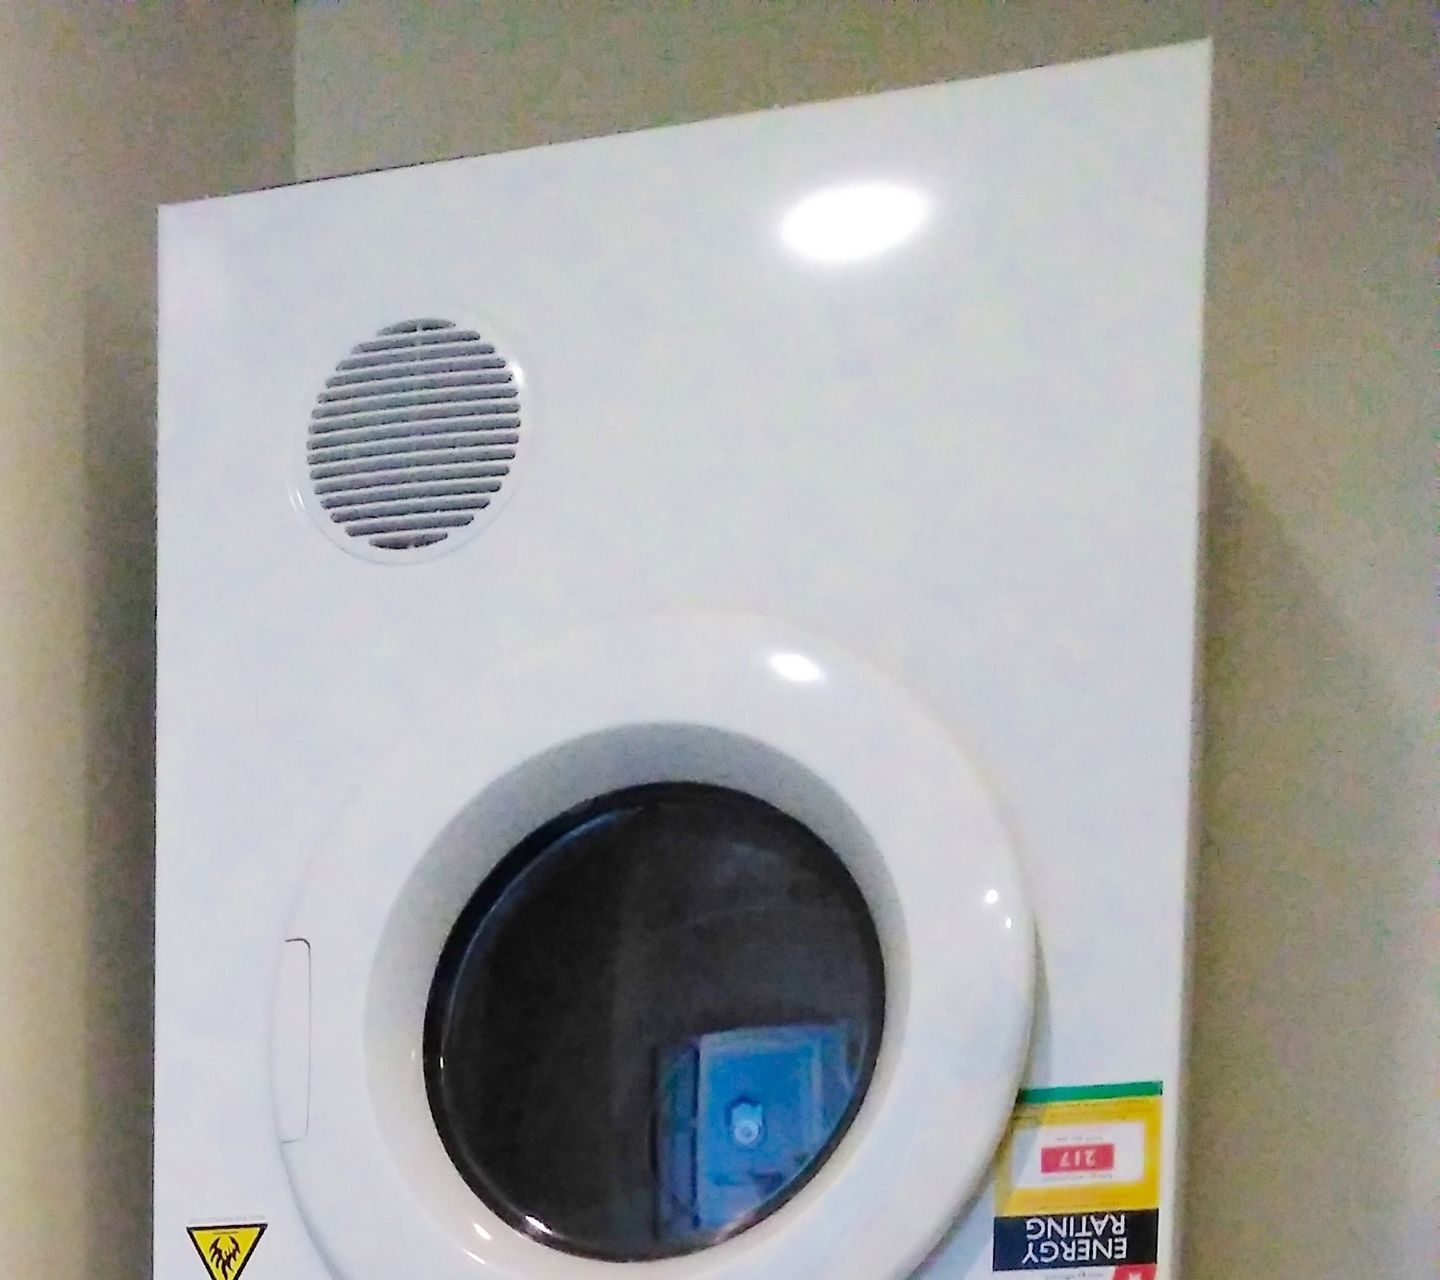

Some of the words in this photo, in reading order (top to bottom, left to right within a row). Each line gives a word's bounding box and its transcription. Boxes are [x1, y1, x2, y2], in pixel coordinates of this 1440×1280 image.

[1057, 1149, 1097, 1168] 217
[1025, 1213, 1127, 1240] RATING
[1022, 1237, 1128, 1265] ENERGY
